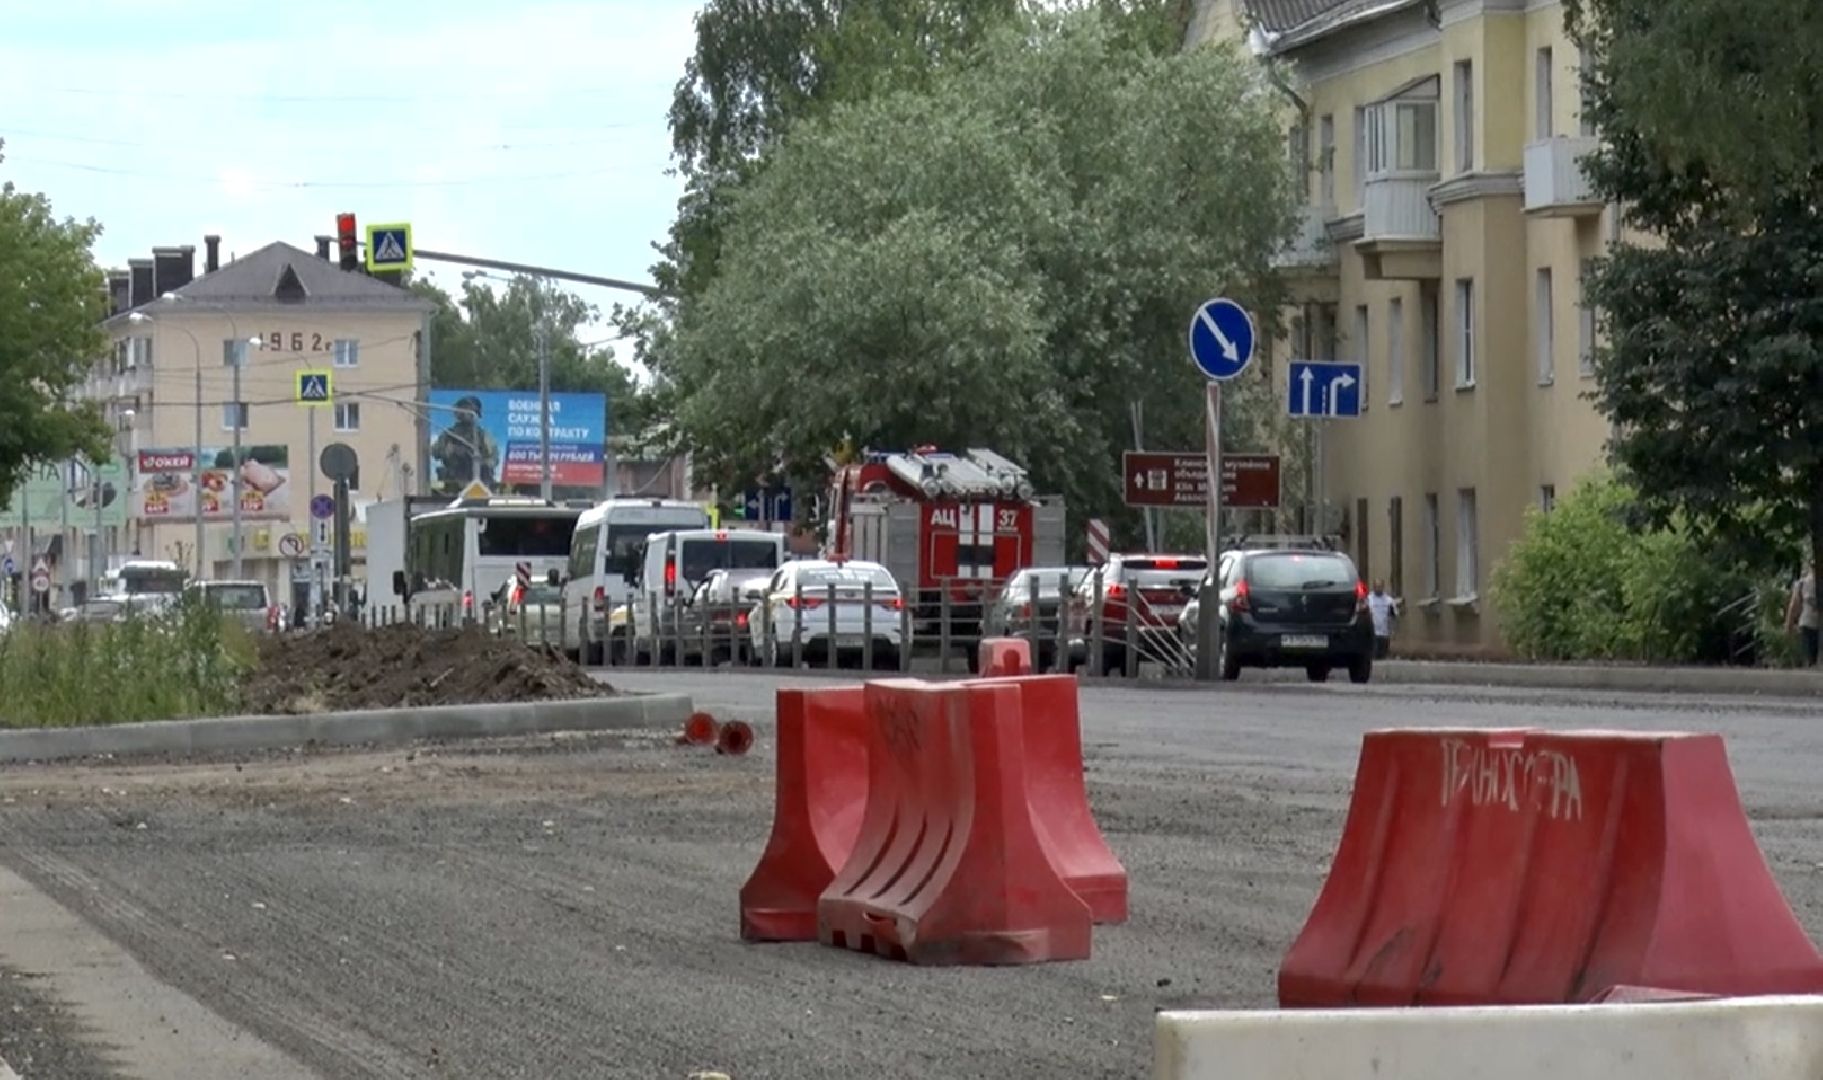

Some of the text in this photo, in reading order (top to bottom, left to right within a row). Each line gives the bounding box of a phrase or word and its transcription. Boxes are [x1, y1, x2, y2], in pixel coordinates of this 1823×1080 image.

[525, 427, 589, 438] КОТРАКТУ
[931, 508, 1018, 529] АЦ 37
